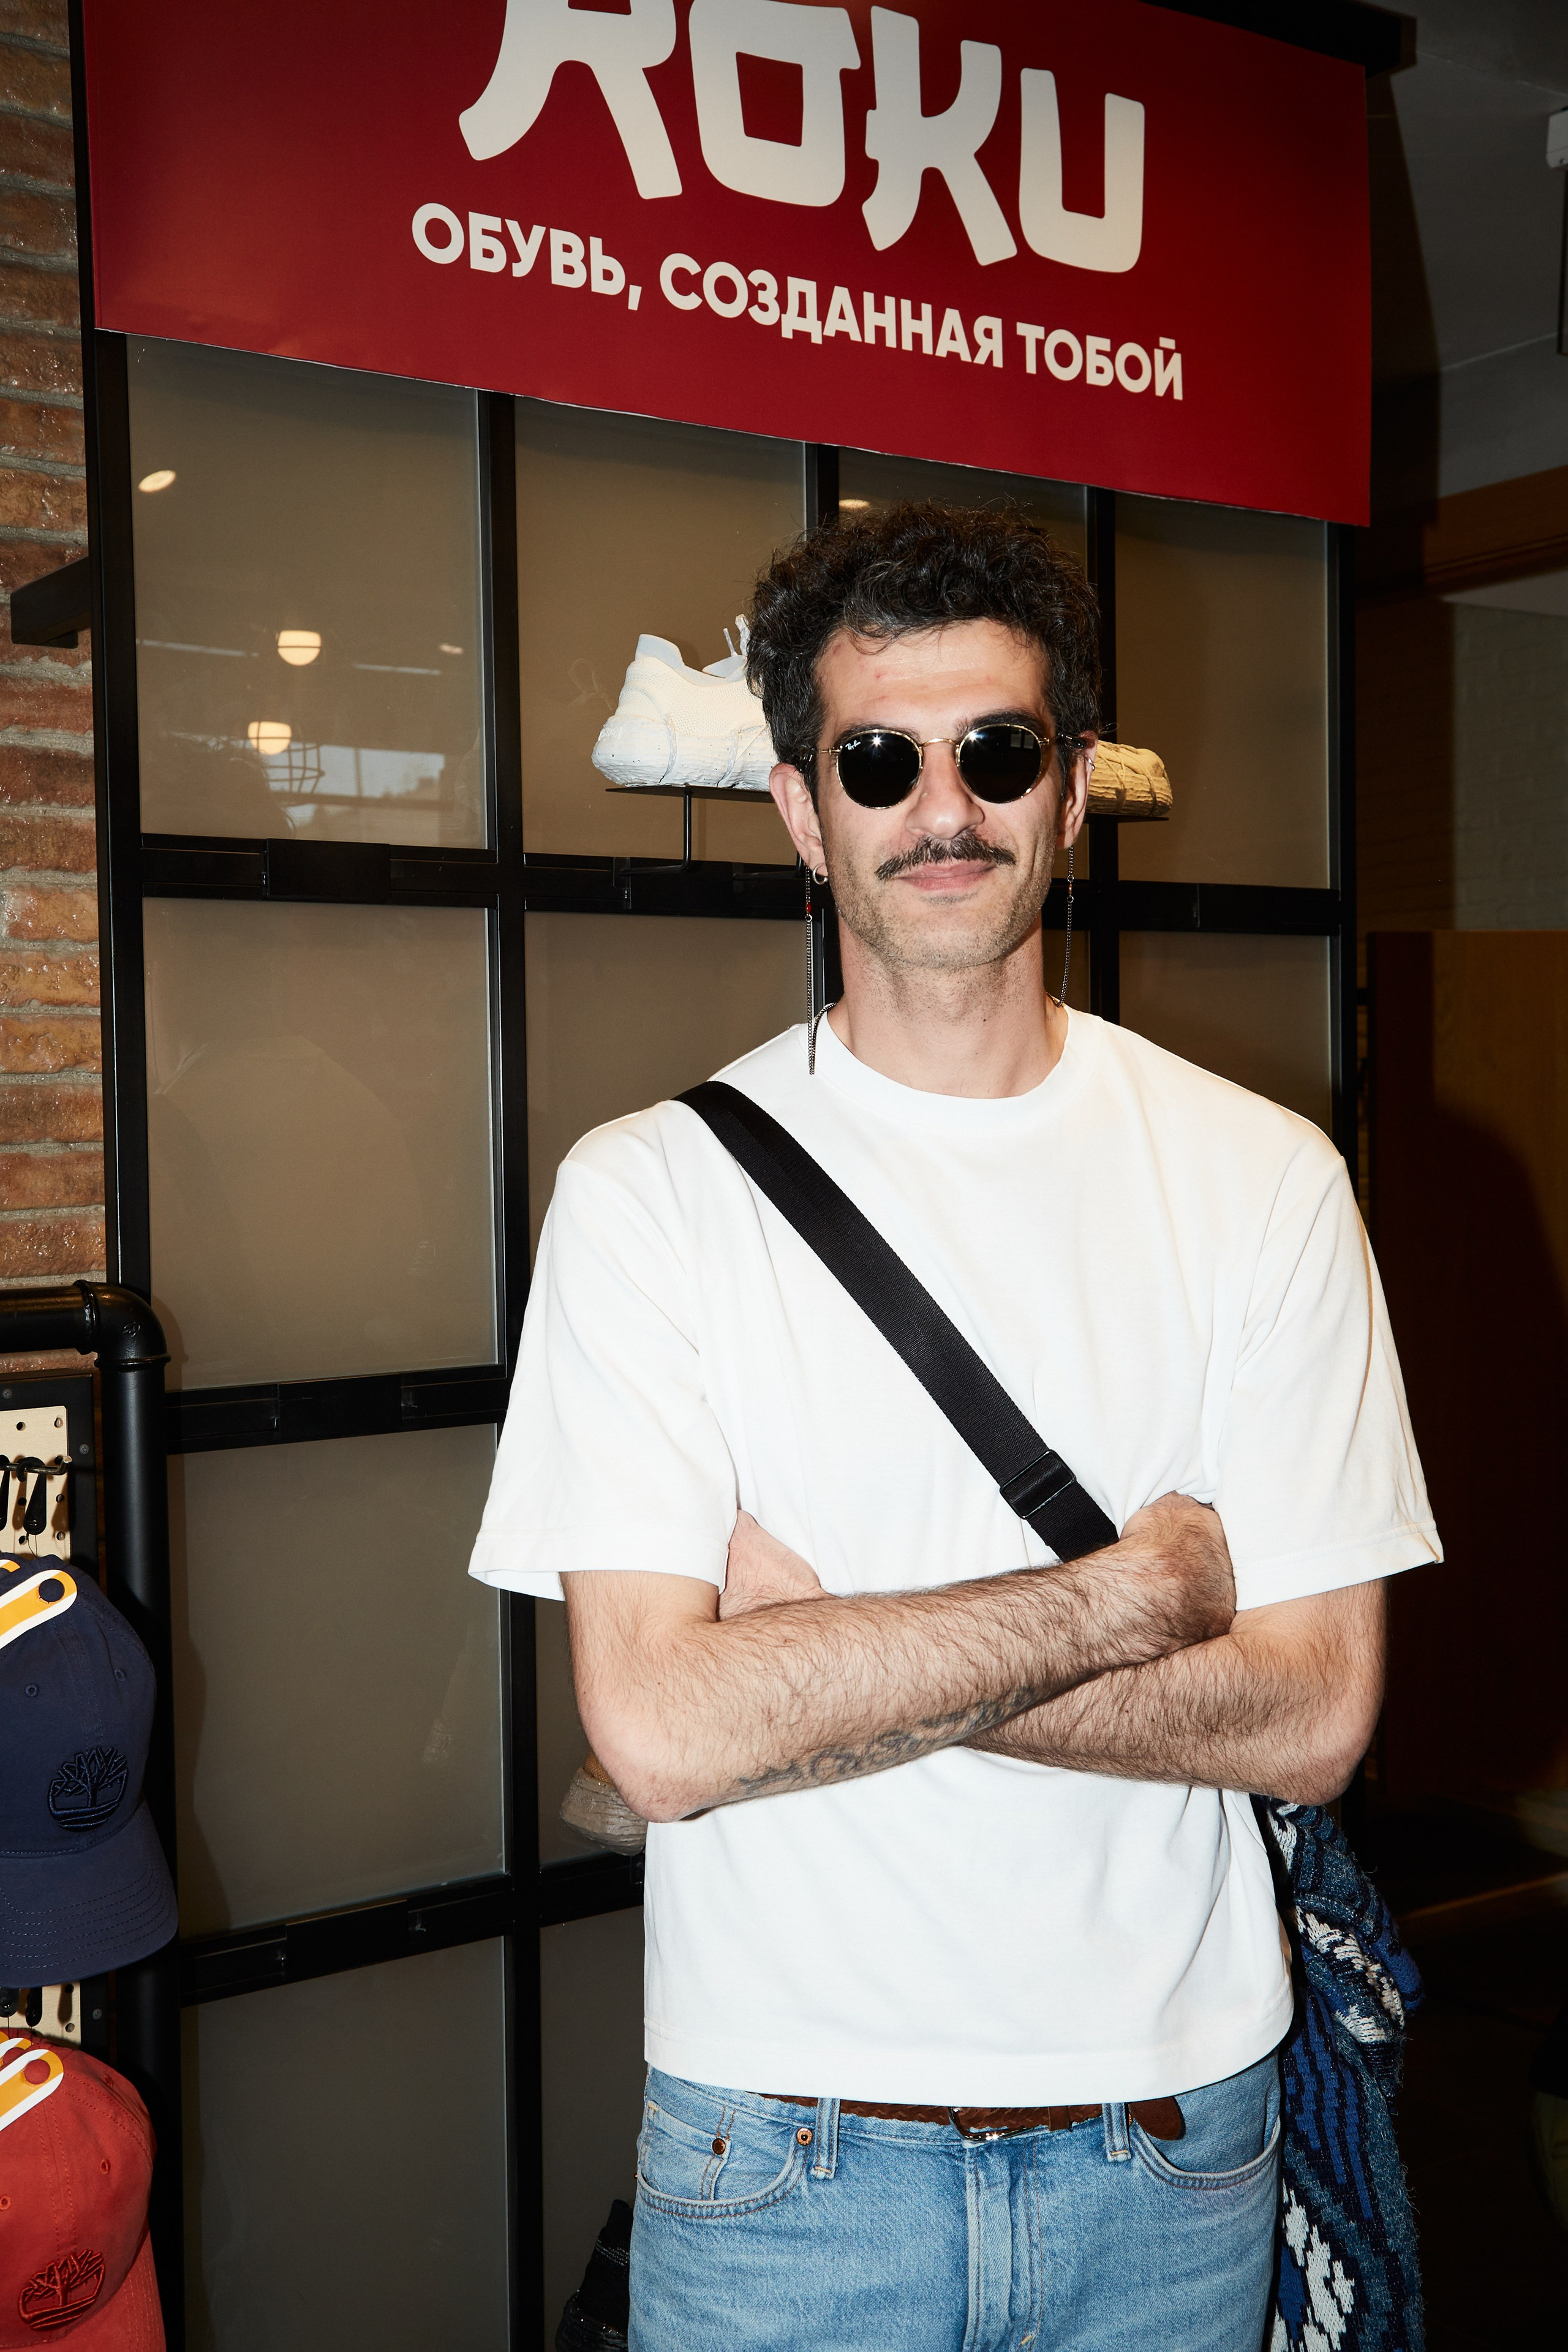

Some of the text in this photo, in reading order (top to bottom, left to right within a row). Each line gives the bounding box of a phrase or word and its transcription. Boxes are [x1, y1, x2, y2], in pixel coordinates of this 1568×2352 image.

[459, 0, 1145, 273] ROKU
[412, 203, 1183, 400] ОБУВЬ, СОЗДАННАЯ ТОБОЙ
